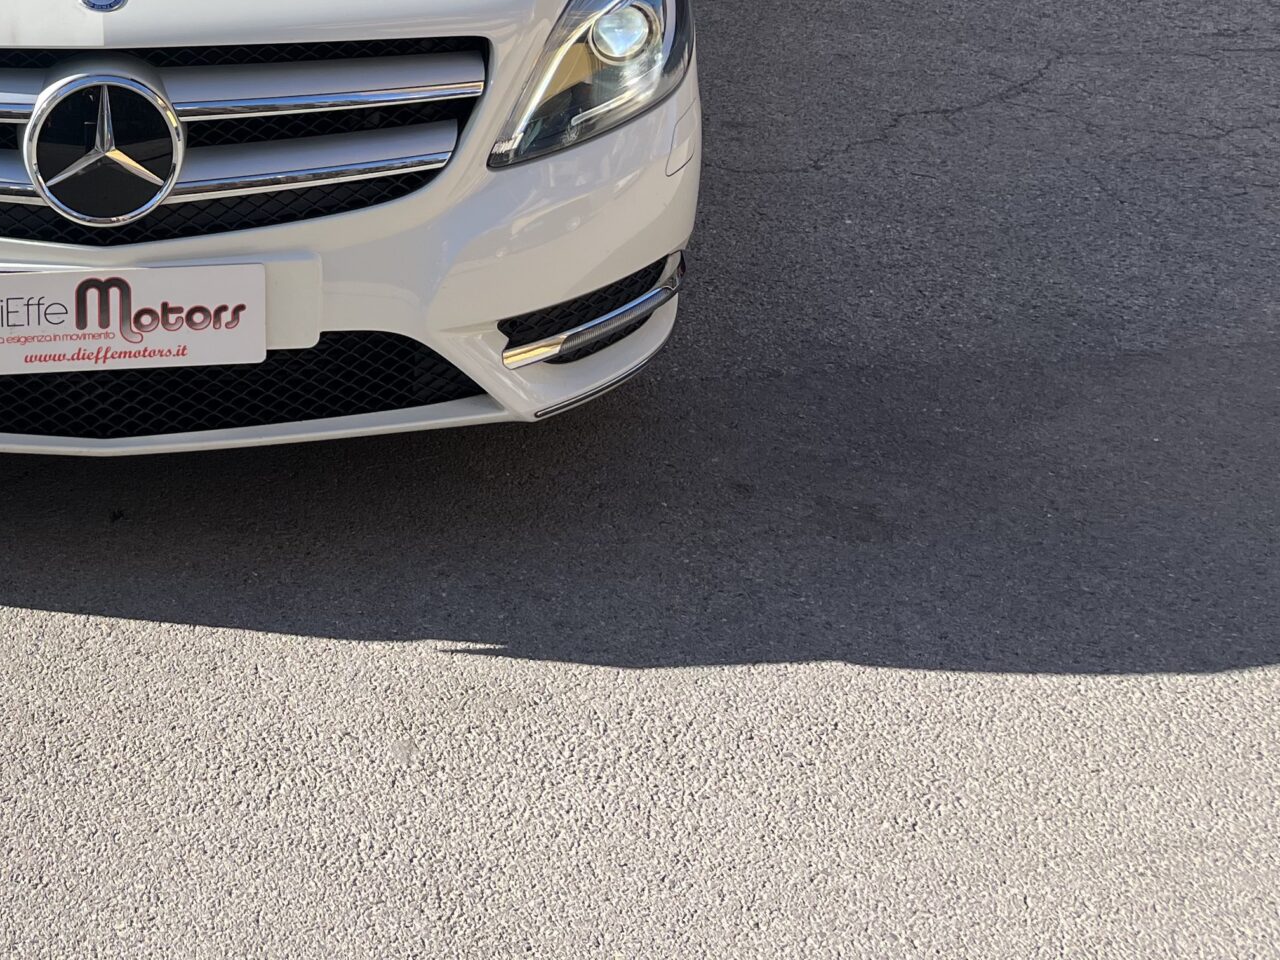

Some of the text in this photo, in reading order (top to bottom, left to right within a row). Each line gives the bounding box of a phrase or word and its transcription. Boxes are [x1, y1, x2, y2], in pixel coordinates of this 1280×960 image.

[75, 276, 247, 344] Motors
[6, 334, 53, 346] esigenza
[62, 331, 116, 341] movimento
[23, 344, 188, 365] www.dieffemotors.it
